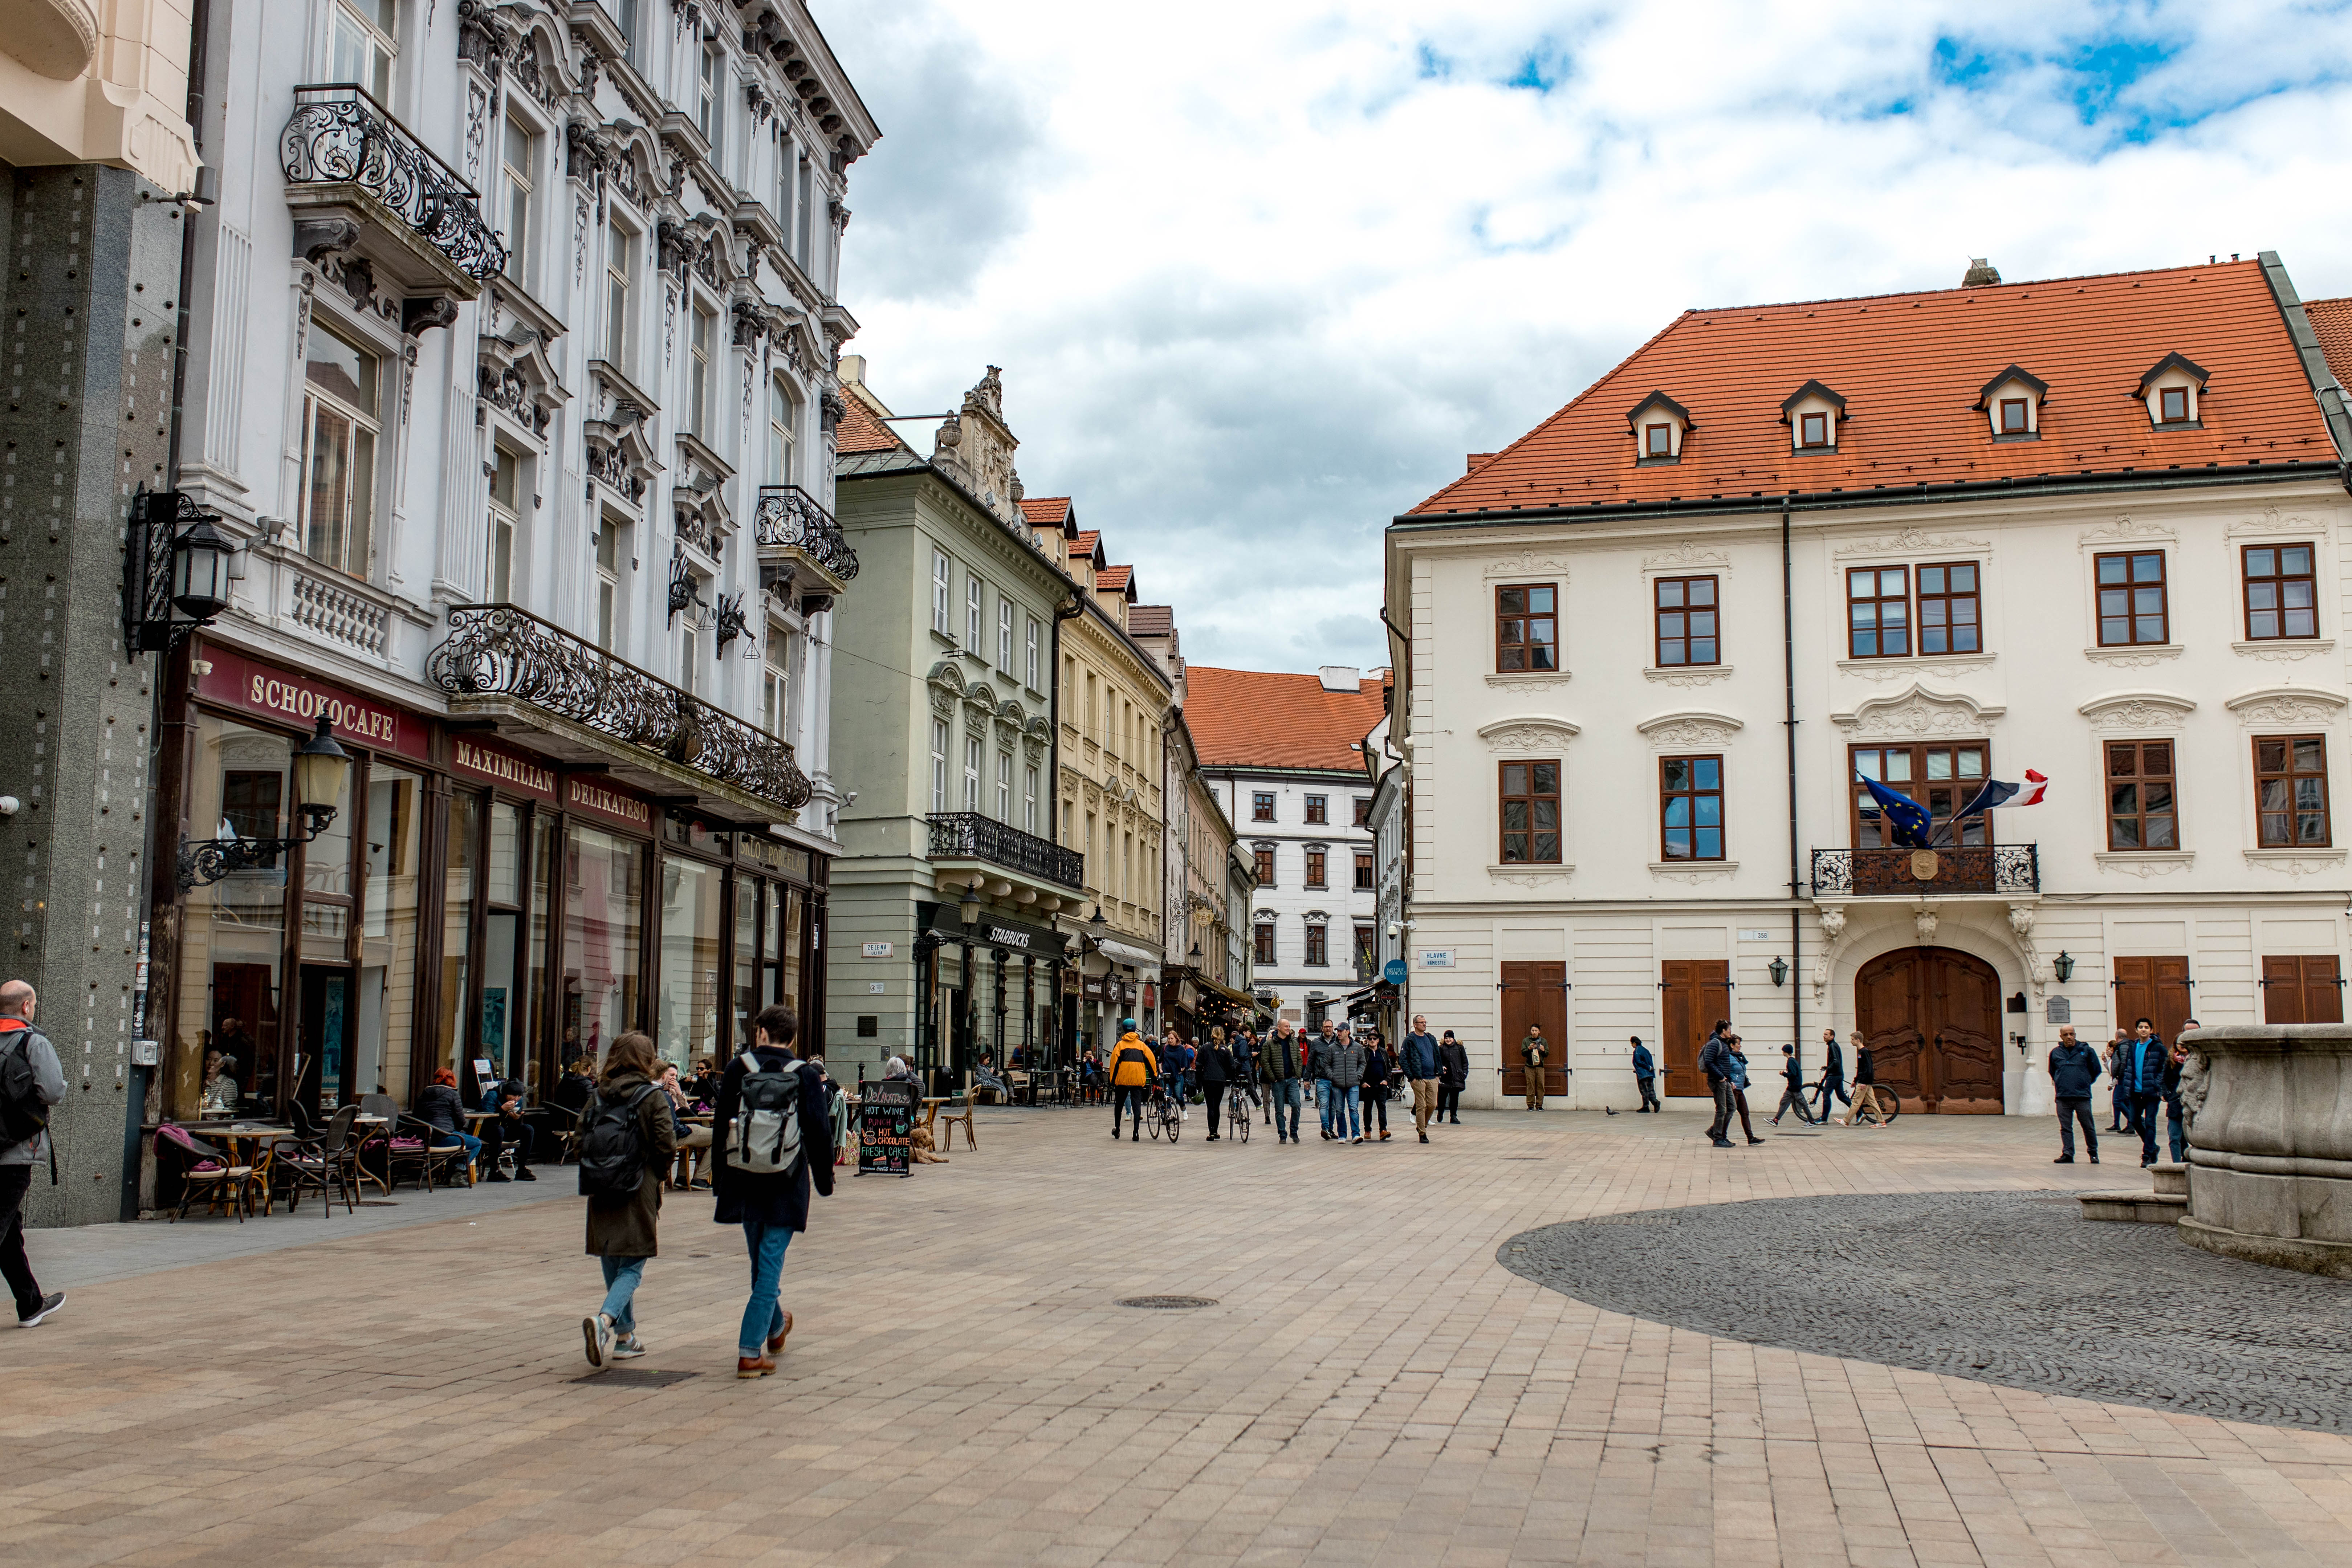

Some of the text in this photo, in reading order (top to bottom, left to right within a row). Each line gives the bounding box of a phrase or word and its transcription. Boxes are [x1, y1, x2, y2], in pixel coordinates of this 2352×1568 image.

[251, 675, 393, 741] SCHOKOCAFE
[457, 741, 648, 822] MAXIMILIAN DELIKATESO
[740, 840, 761, 859] SKLO
[989, 927, 1030, 948] STARBUCKS
[865, 1106, 879, 1115] HOT
[879, 1128, 892, 1136] HOT
[878, 1137, 910, 1146] CHOCOLATE
[861, 1147, 908, 1157] FRESH CAKE
